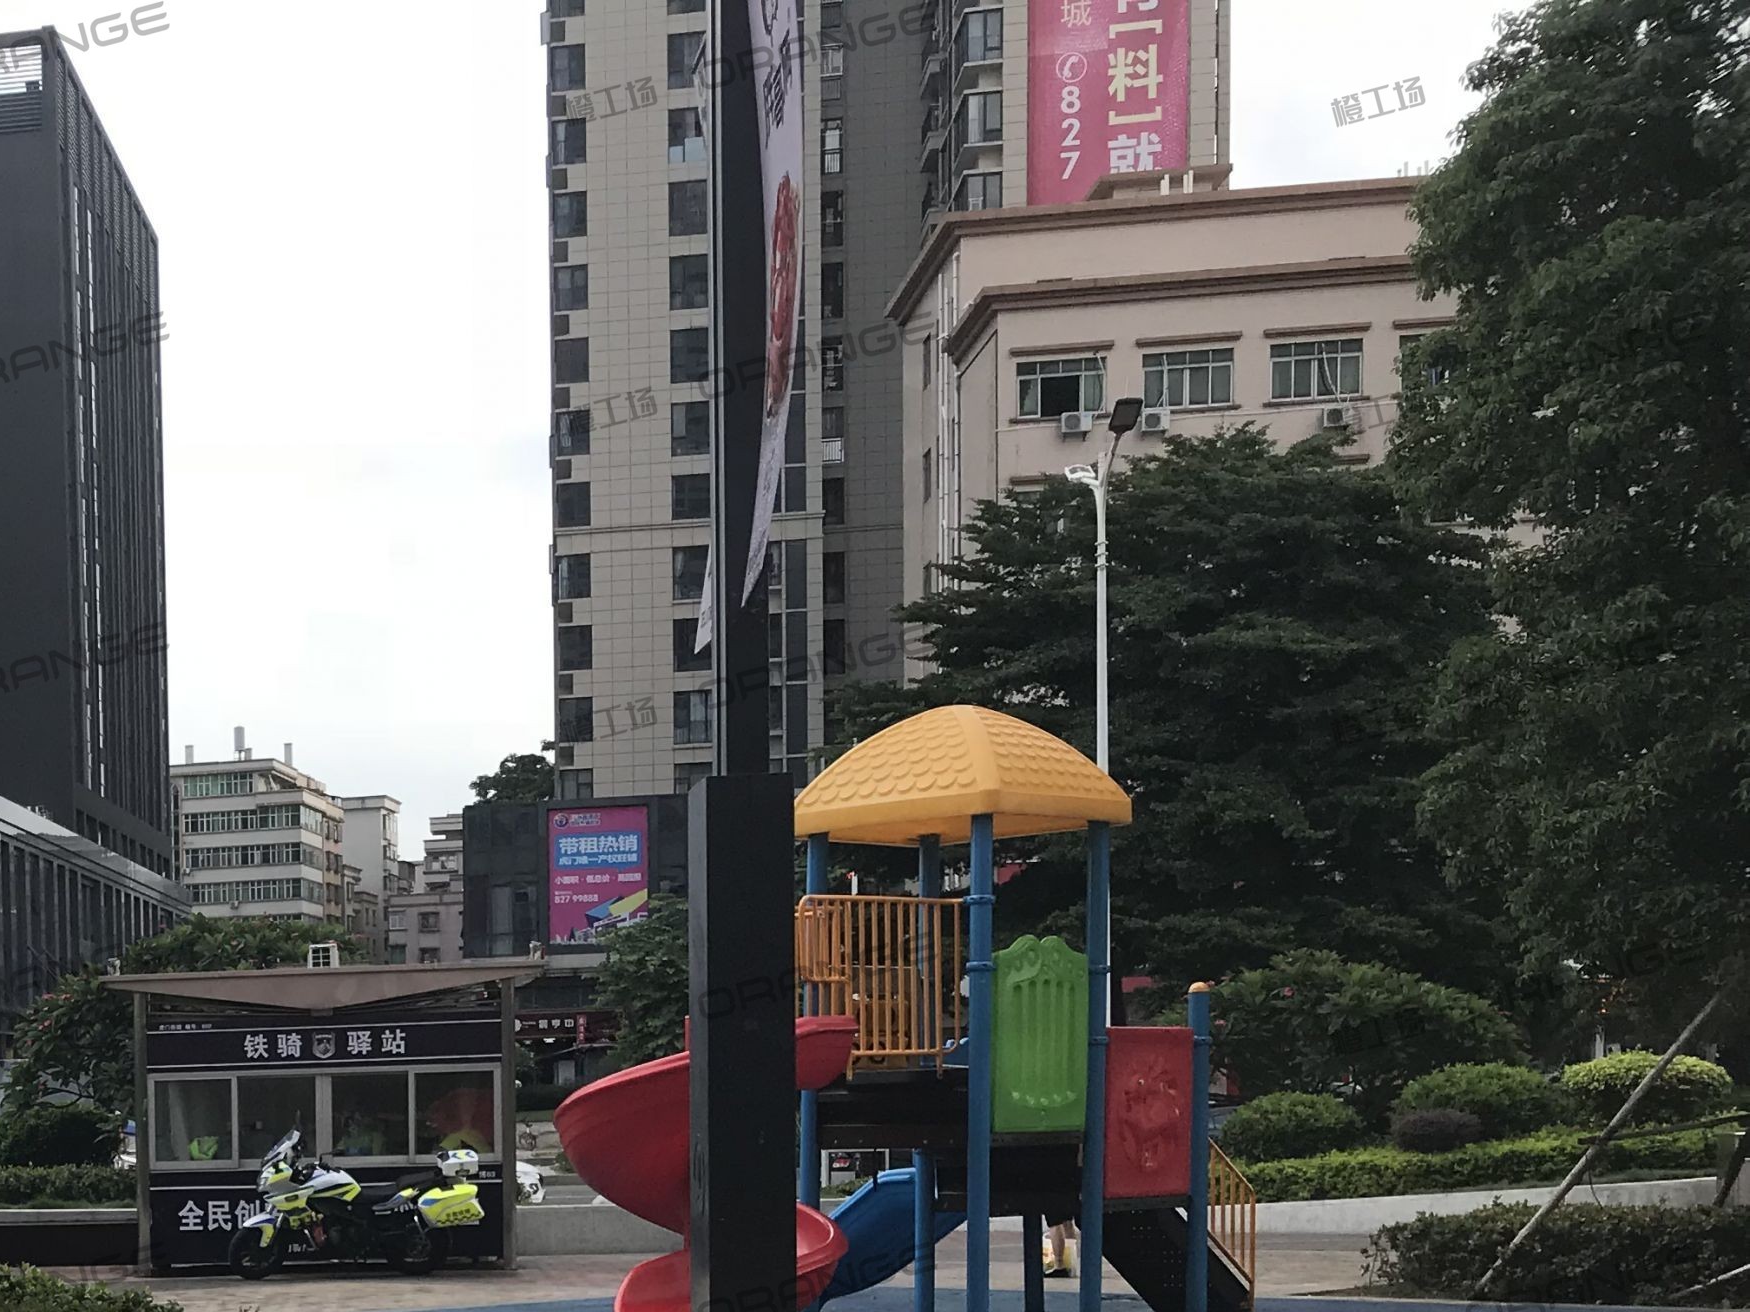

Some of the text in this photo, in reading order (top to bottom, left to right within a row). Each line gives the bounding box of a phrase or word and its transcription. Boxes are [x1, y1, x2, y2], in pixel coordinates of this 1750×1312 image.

[1061, 86, 1080, 181] 827
[559, 835, 638, 854] 带租热销
[244, 1029, 406, 1058] 铁骑 驿站
[178, 1200, 279, 1231] 全民创
